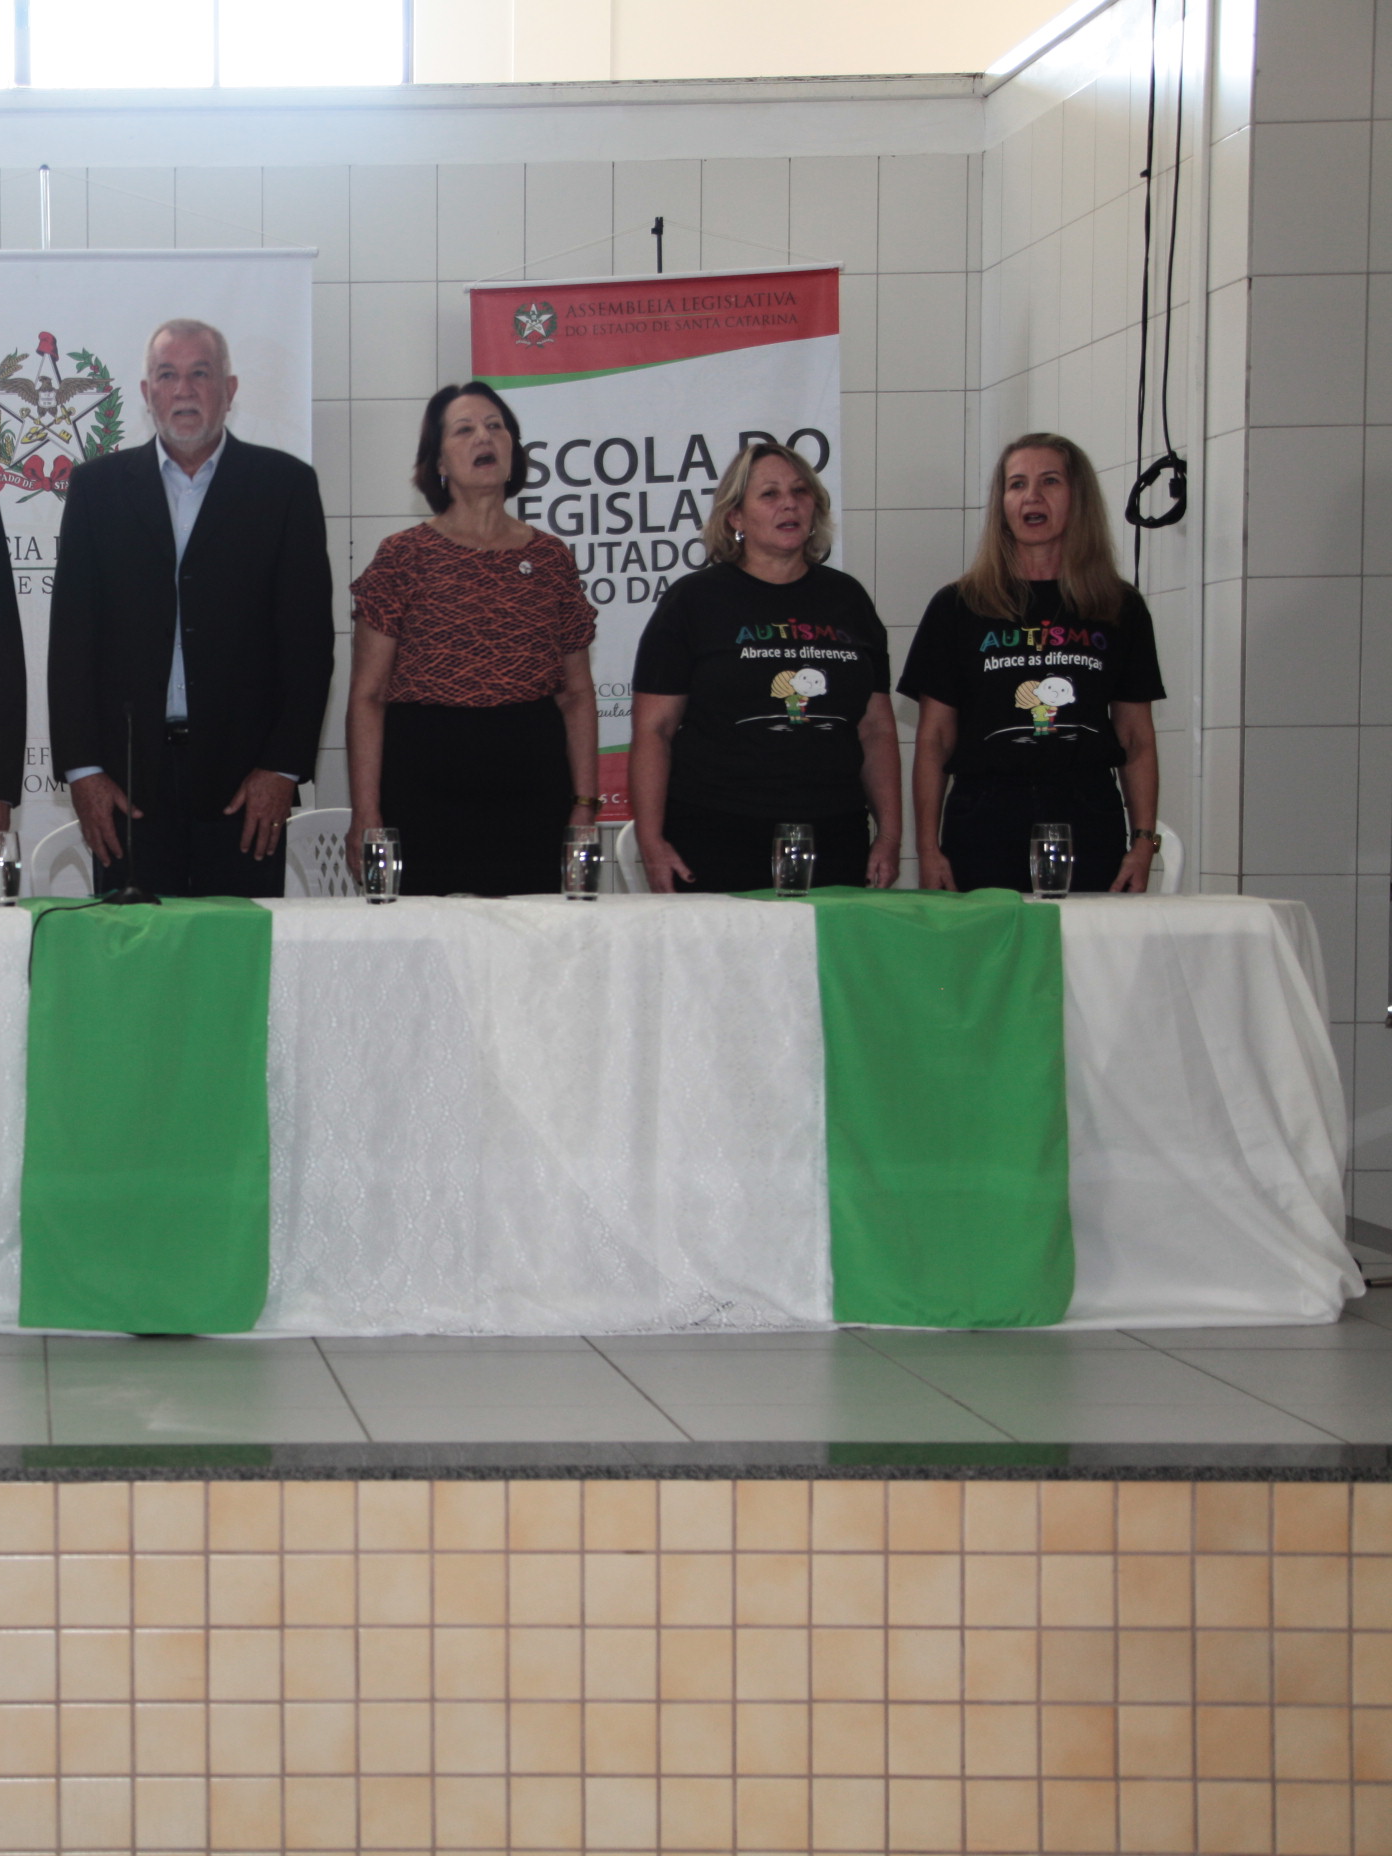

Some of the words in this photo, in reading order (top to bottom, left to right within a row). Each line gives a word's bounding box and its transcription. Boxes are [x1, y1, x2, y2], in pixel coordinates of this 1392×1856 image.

[565, 299, 675, 319] ASSEMBLEIA
[683, 291, 798, 312] LEGISLATIVA
[565, 325, 588, 337] DO
[593, 321, 648, 335] ESTADO
[652, 320, 671, 332] DE
[675, 317, 721, 331] SANTA
[725, 313, 798, 328] CATARINA
[526, 433, 719, 490] SCOLA
[22, 478, 36, 489] DE
[569, 537, 710, 576] UTADO
[740, 647, 781, 660] Abrace
[784, 648, 797, 659] as
[799, 645, 858, 662] diferenças
[983, 656, 1025, 673] Abrace
[1028, 655, 1042, 666] as
[1044, 651, 1103, 671] diferenças
